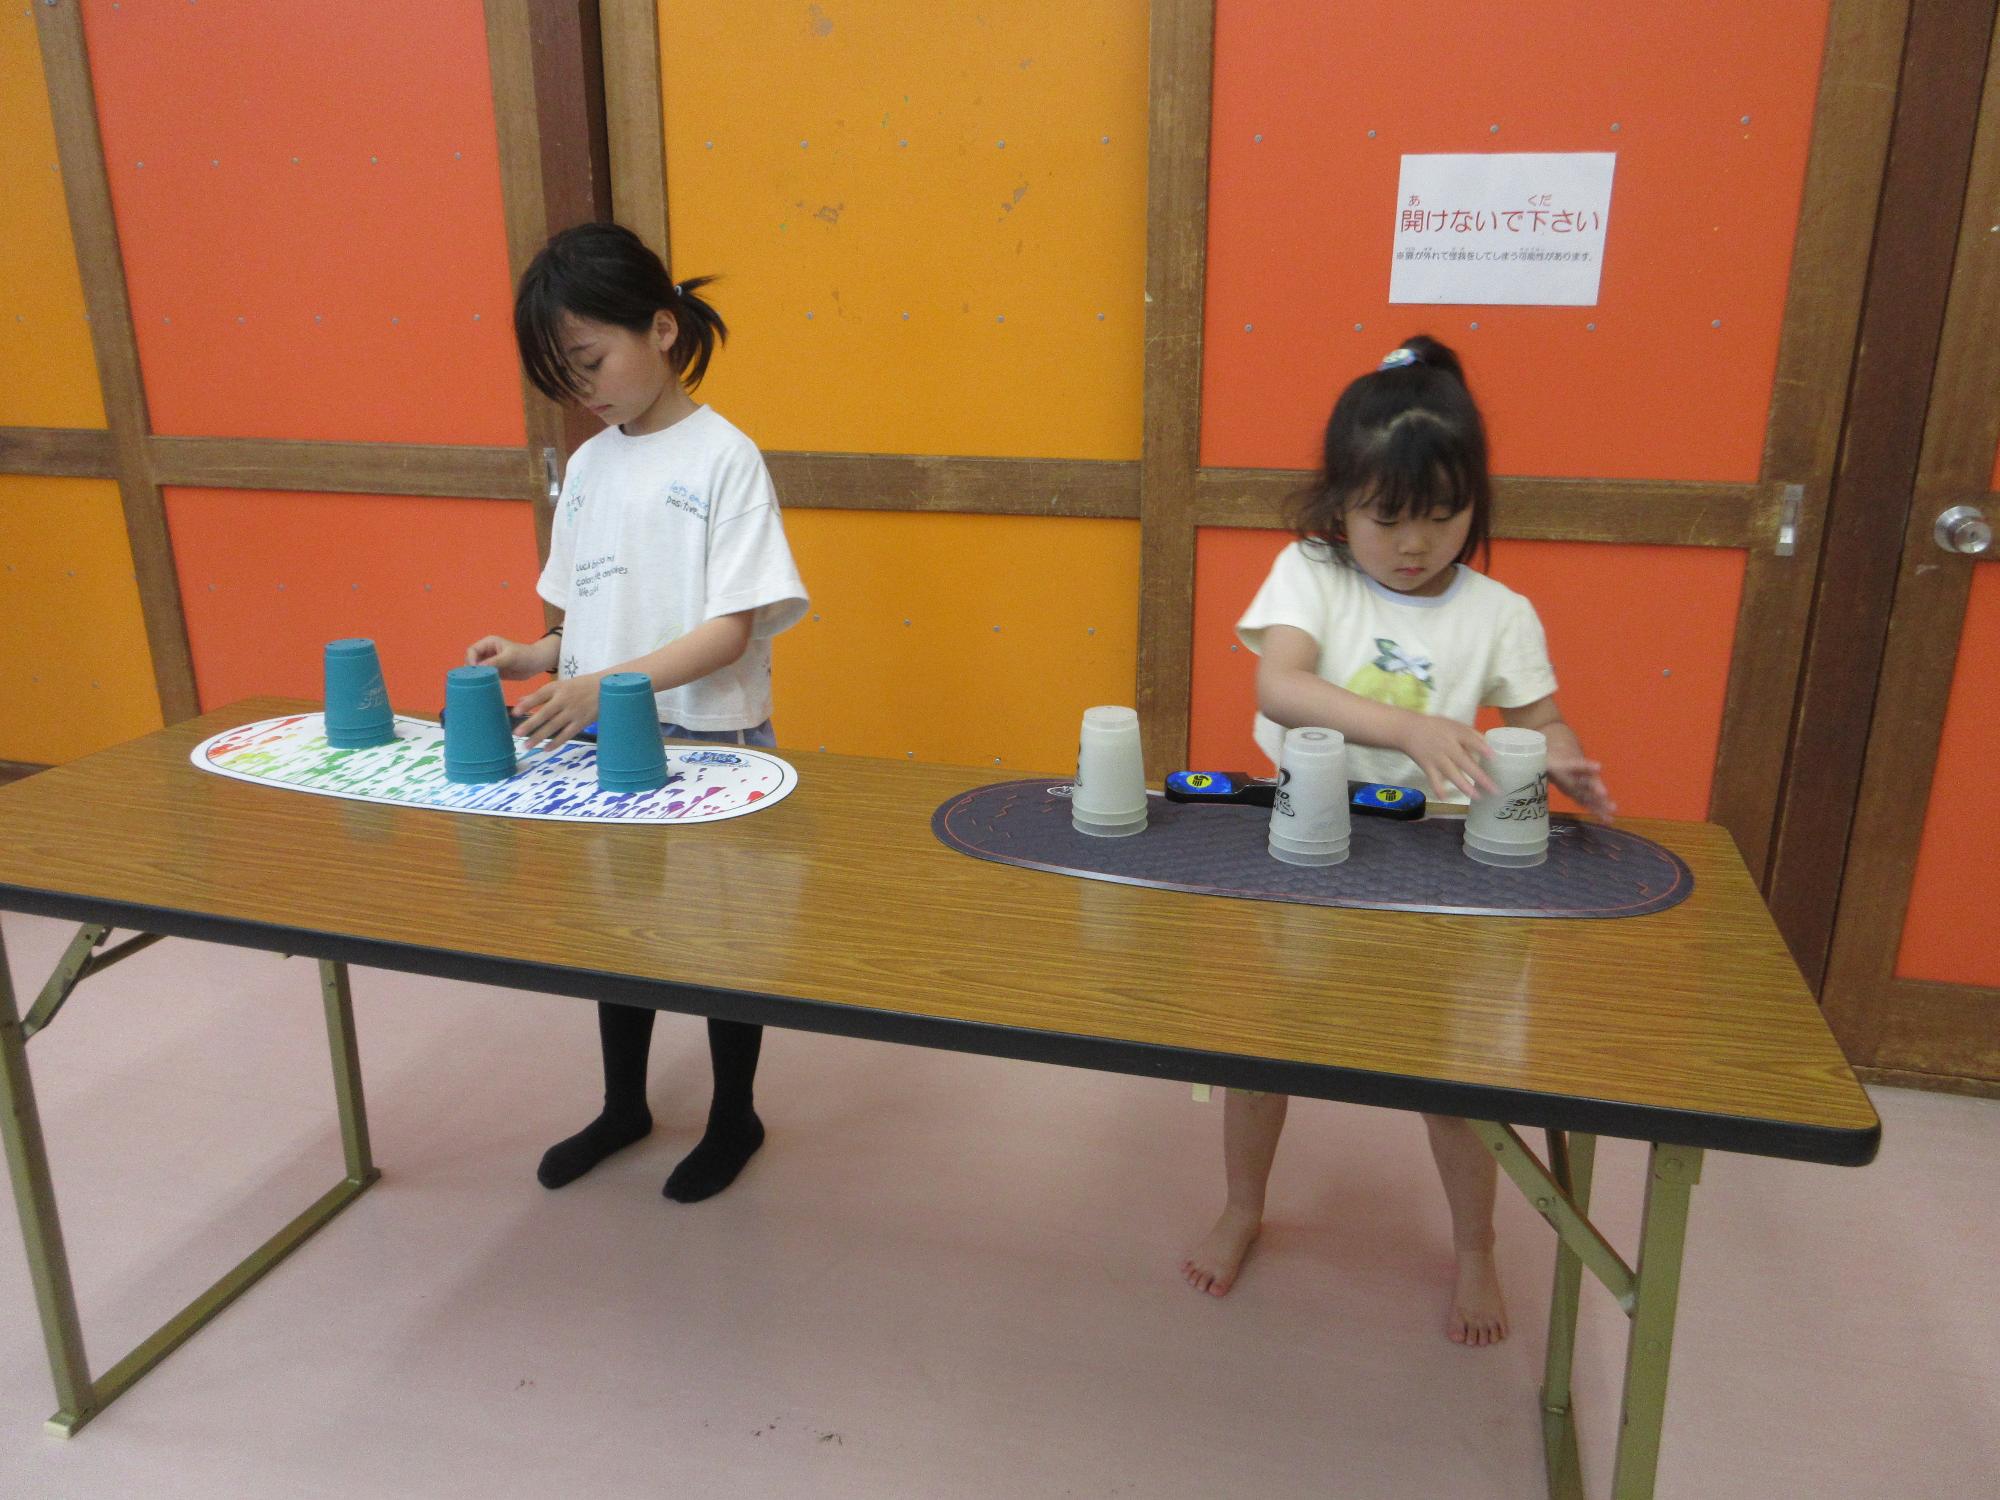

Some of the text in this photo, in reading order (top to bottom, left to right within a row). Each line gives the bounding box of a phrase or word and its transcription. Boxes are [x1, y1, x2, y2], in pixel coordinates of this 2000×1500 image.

[1408, 194, 1552, 207] あ くだ
[1400, 209, 1600, 233] 開けないで下さい
